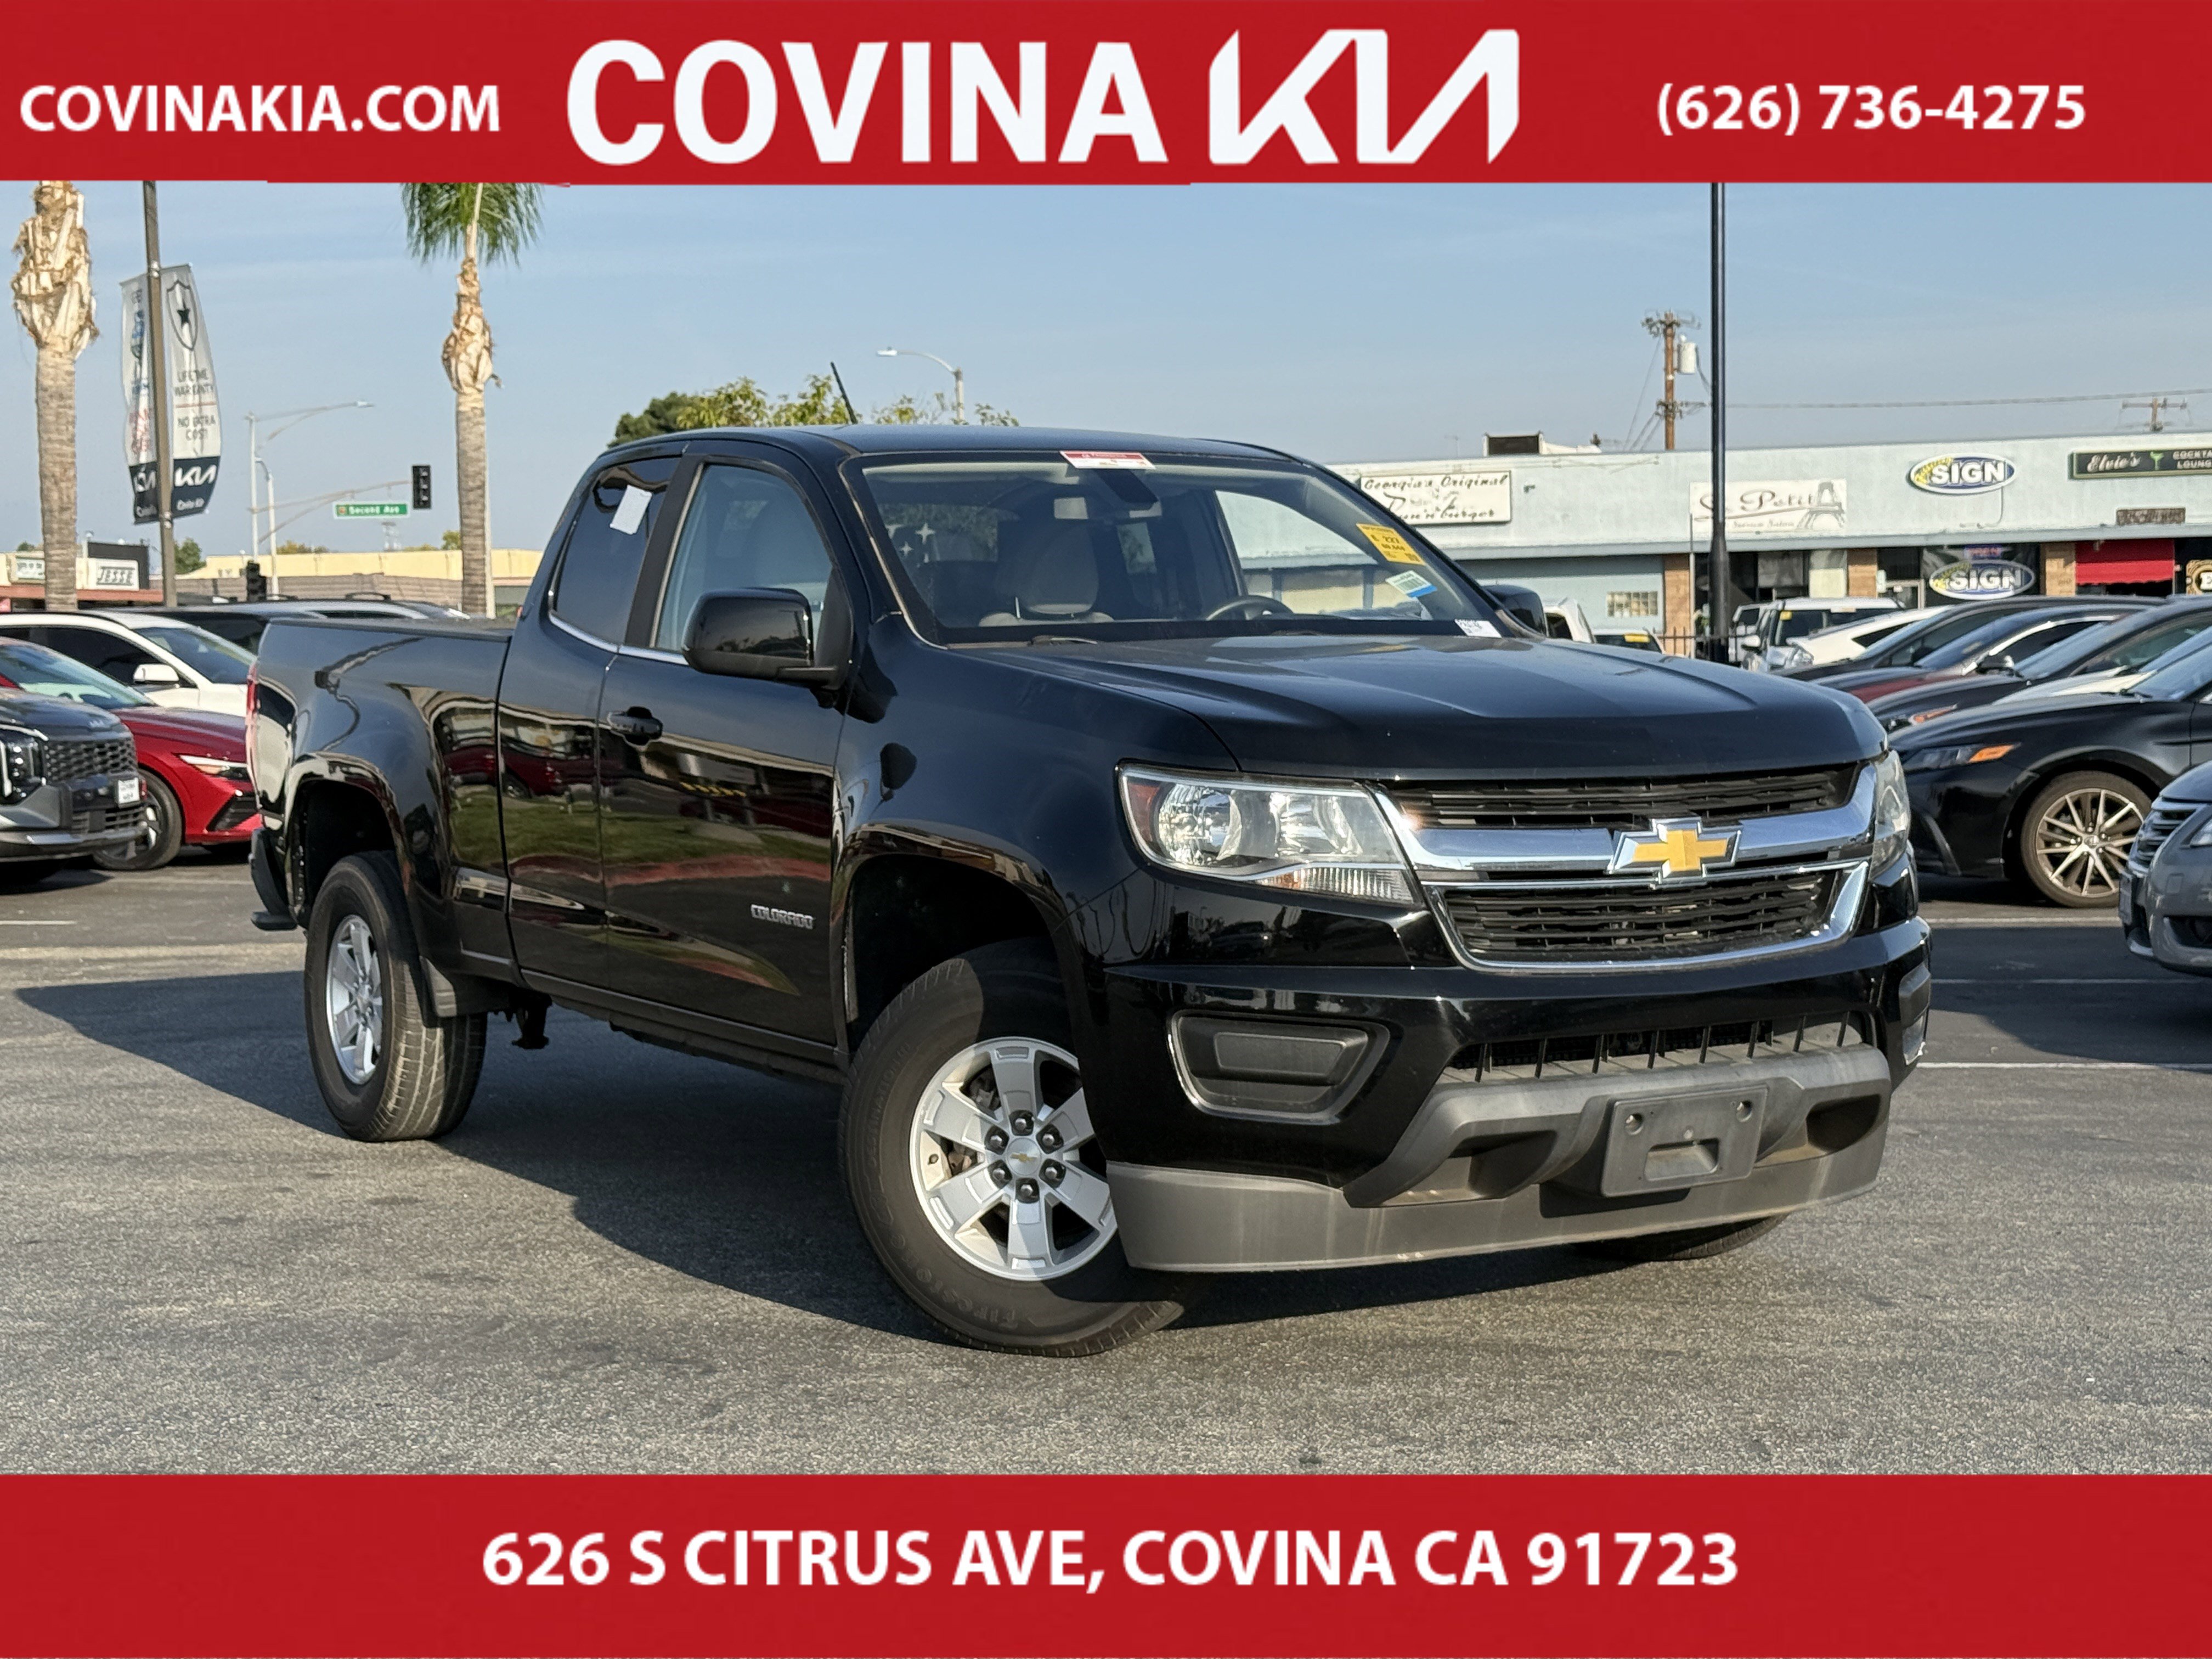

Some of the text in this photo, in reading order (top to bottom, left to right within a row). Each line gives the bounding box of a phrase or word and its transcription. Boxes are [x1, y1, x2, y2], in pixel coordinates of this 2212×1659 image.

[1441, 473, 1508, 489] Original
[1930, 460, 2006, 485] SIGN
[348, 506, 380, 515] Second
[1948, 568, 2024, 591] SIGN
[751, 904, 814, 929] COLORADO
